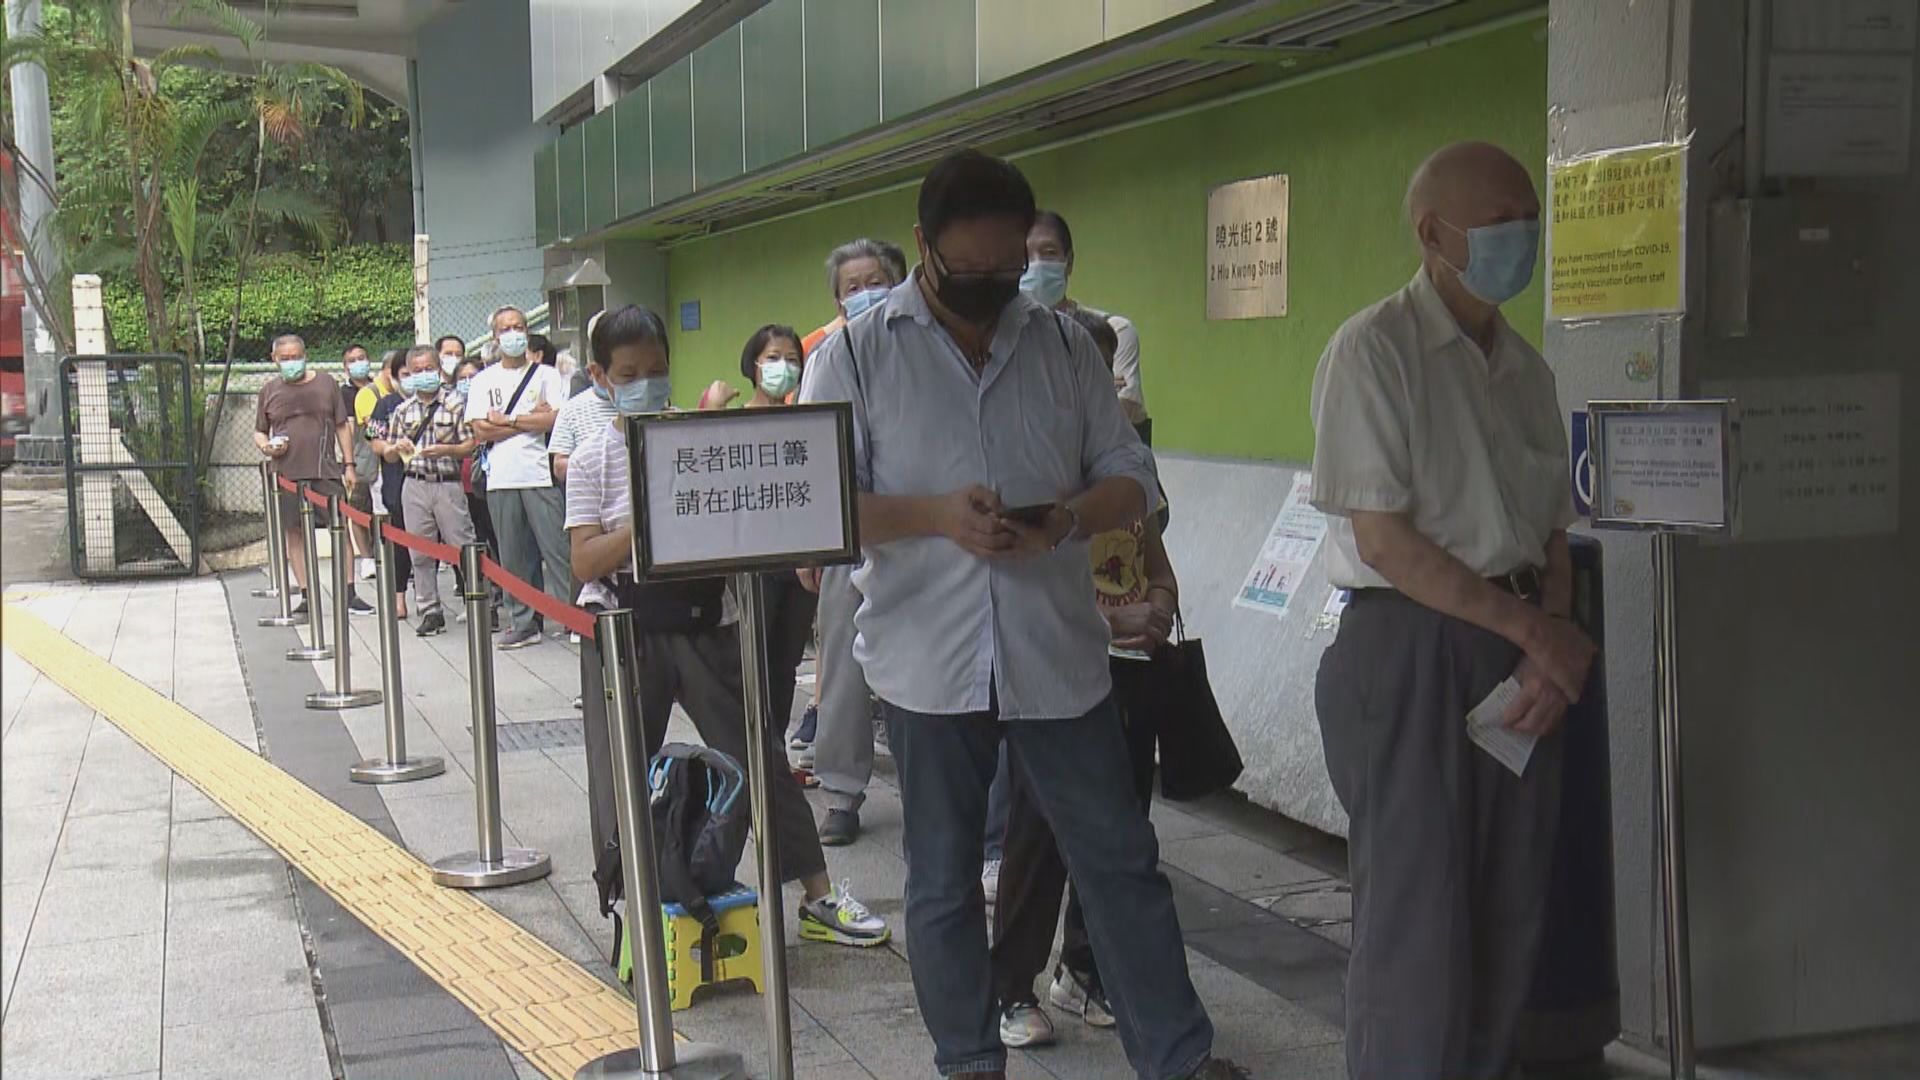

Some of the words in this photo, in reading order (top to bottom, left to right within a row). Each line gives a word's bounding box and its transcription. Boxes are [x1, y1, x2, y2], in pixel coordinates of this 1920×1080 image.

[1211, 264, 1216, 281] 2
[1217, 263, 1230, 281] Hiu
[1231, 262, 1257, 281] Kwong
[1259, 258, 1282, 277] Street
[1580, 264, 1610, 275] reminded
[1585, 277, 1623, 288] Vaccination
[1624, 274, 1647, 285] Center
[1649, 272, 1665, 283] staff
[485, 383, 503, 408] 18
[672, 439, 809, 475] 長者即日籌
[674, 480, 812, 517] 請在此排隊
